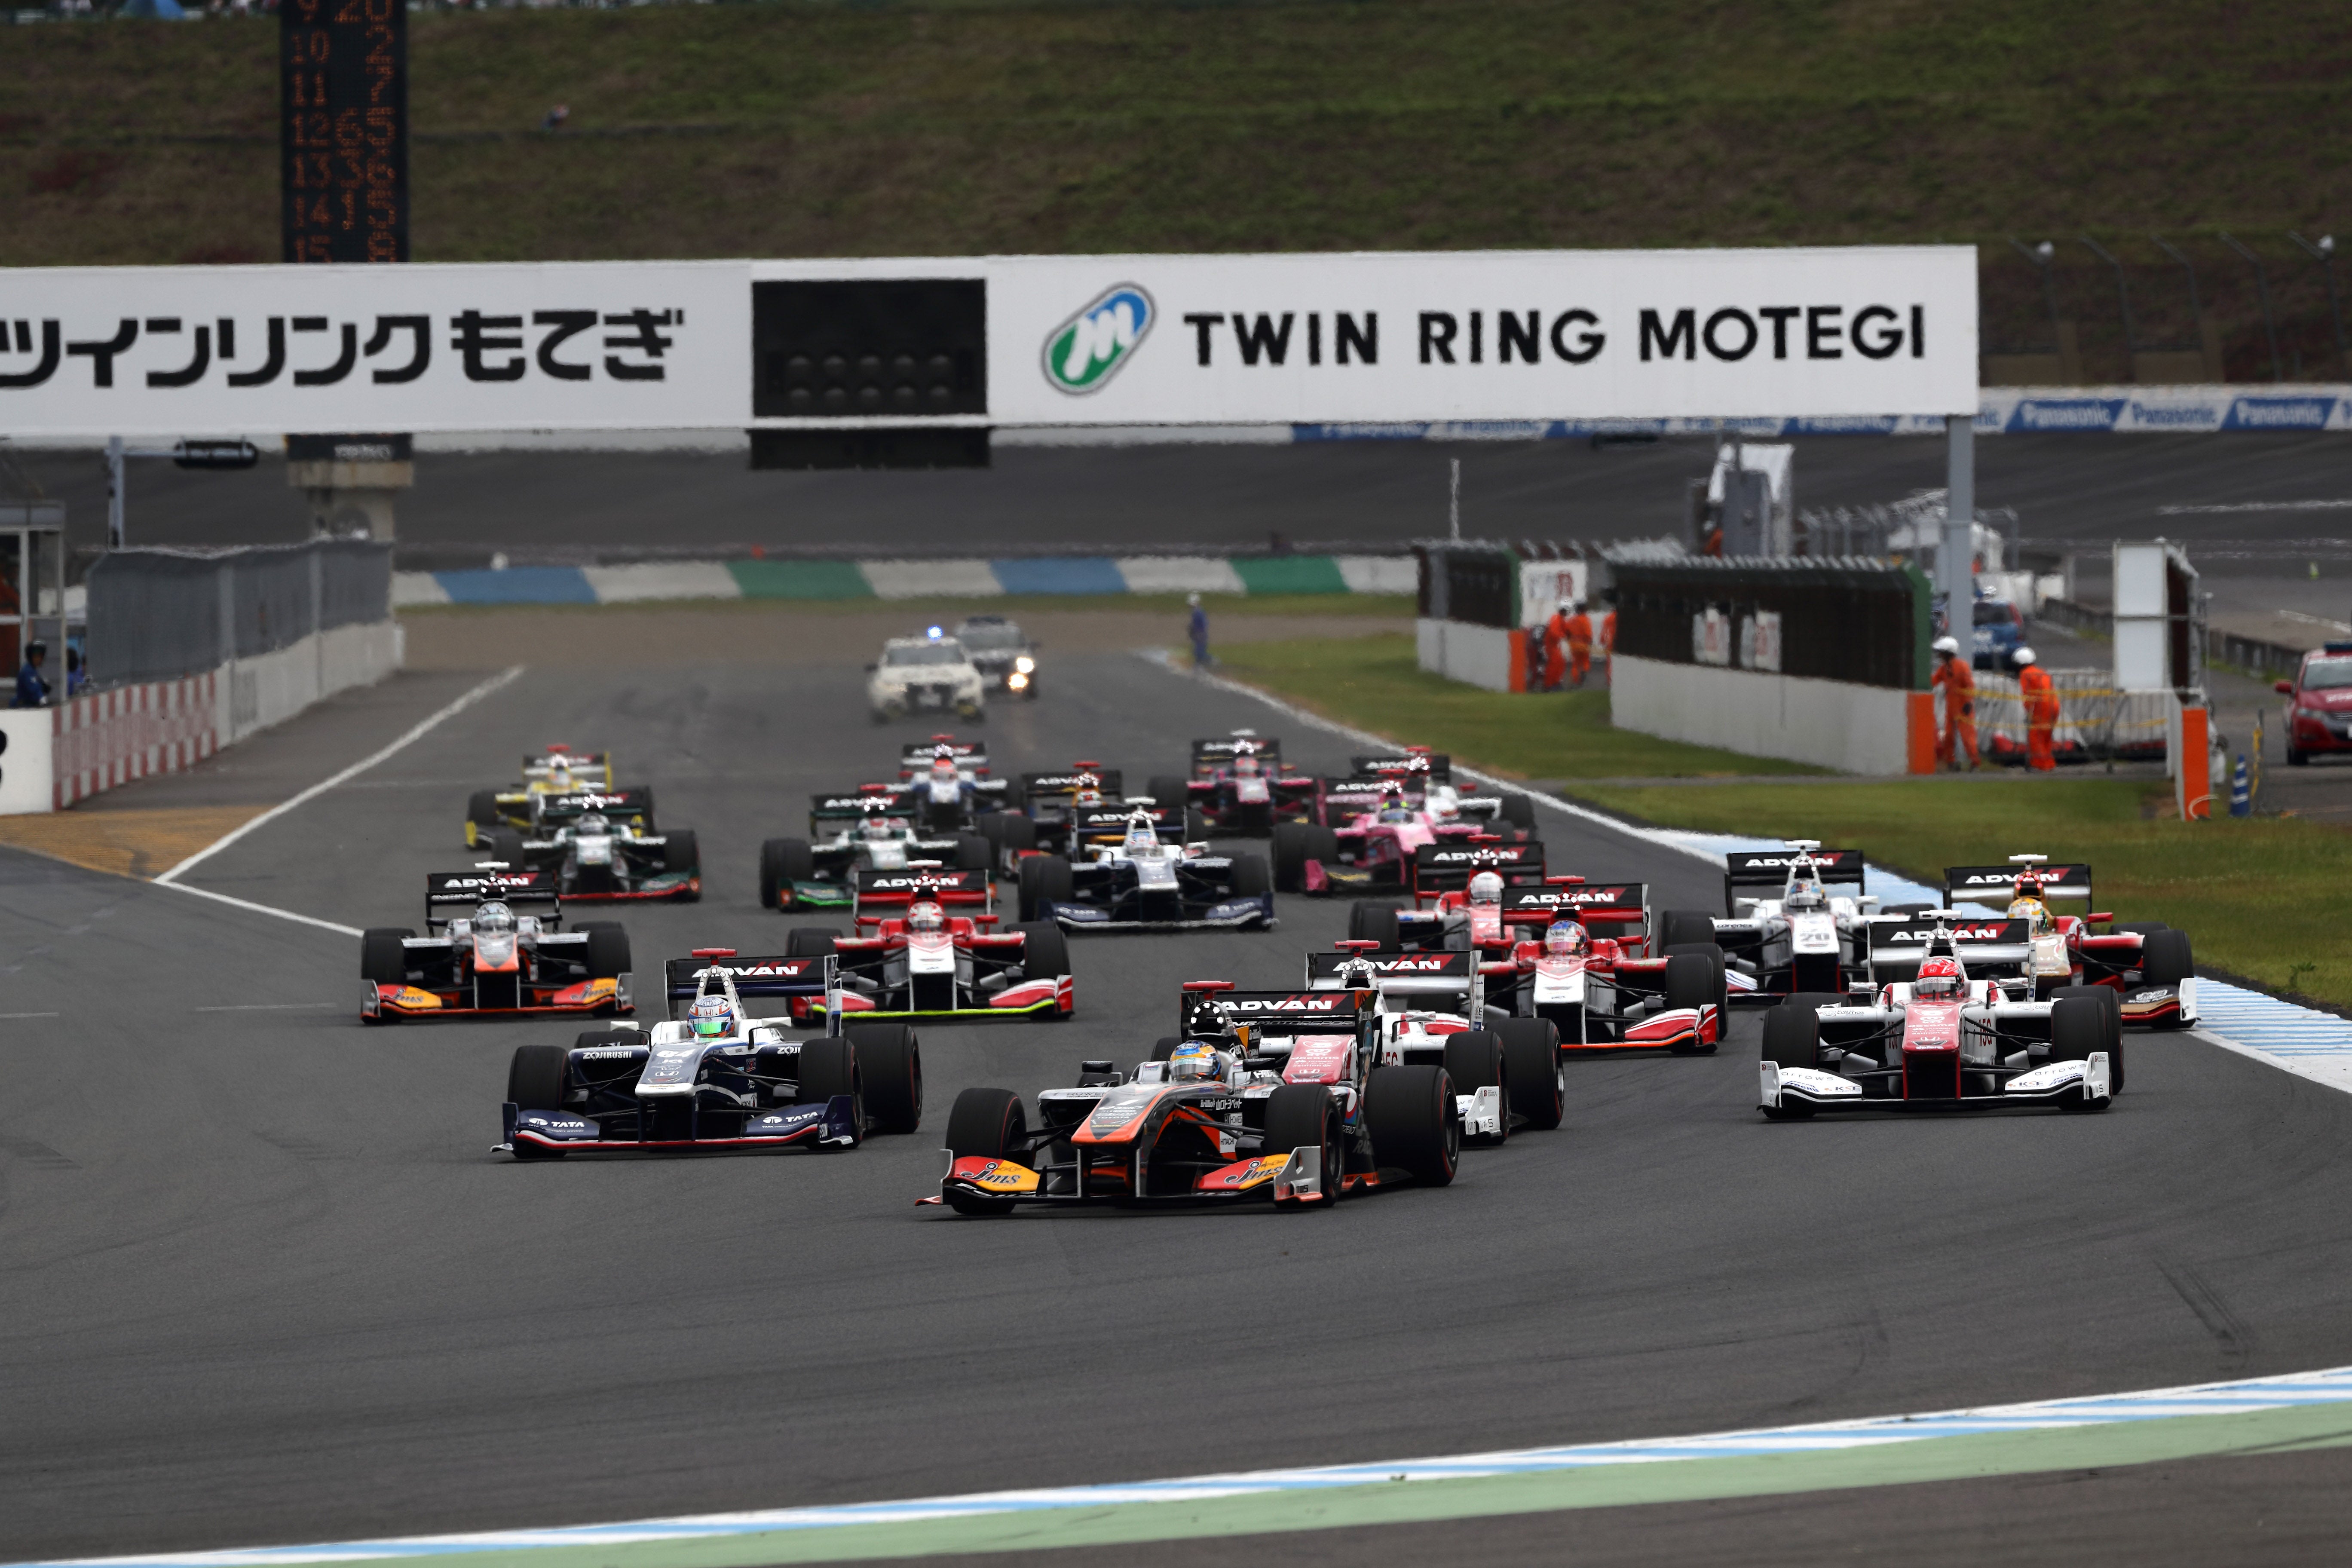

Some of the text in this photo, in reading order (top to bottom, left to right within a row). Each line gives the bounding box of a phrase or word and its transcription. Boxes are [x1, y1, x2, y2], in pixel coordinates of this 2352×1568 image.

[292, 112, 332, 147] 12
[1184, 305, 1925, 367] TWIN RING MOTEGI
[1222, 1000, 1332, 1011] ADVAN
[583, 1050, 632, 1060] ZOJIRUSHI
[656, 1049, 696, 1057] 64
[2034, 1064, 2086, 1076] arrows
[1781, 1072, 1834, 1081] arrows
[786, 1112, 818, 1123] TATA
